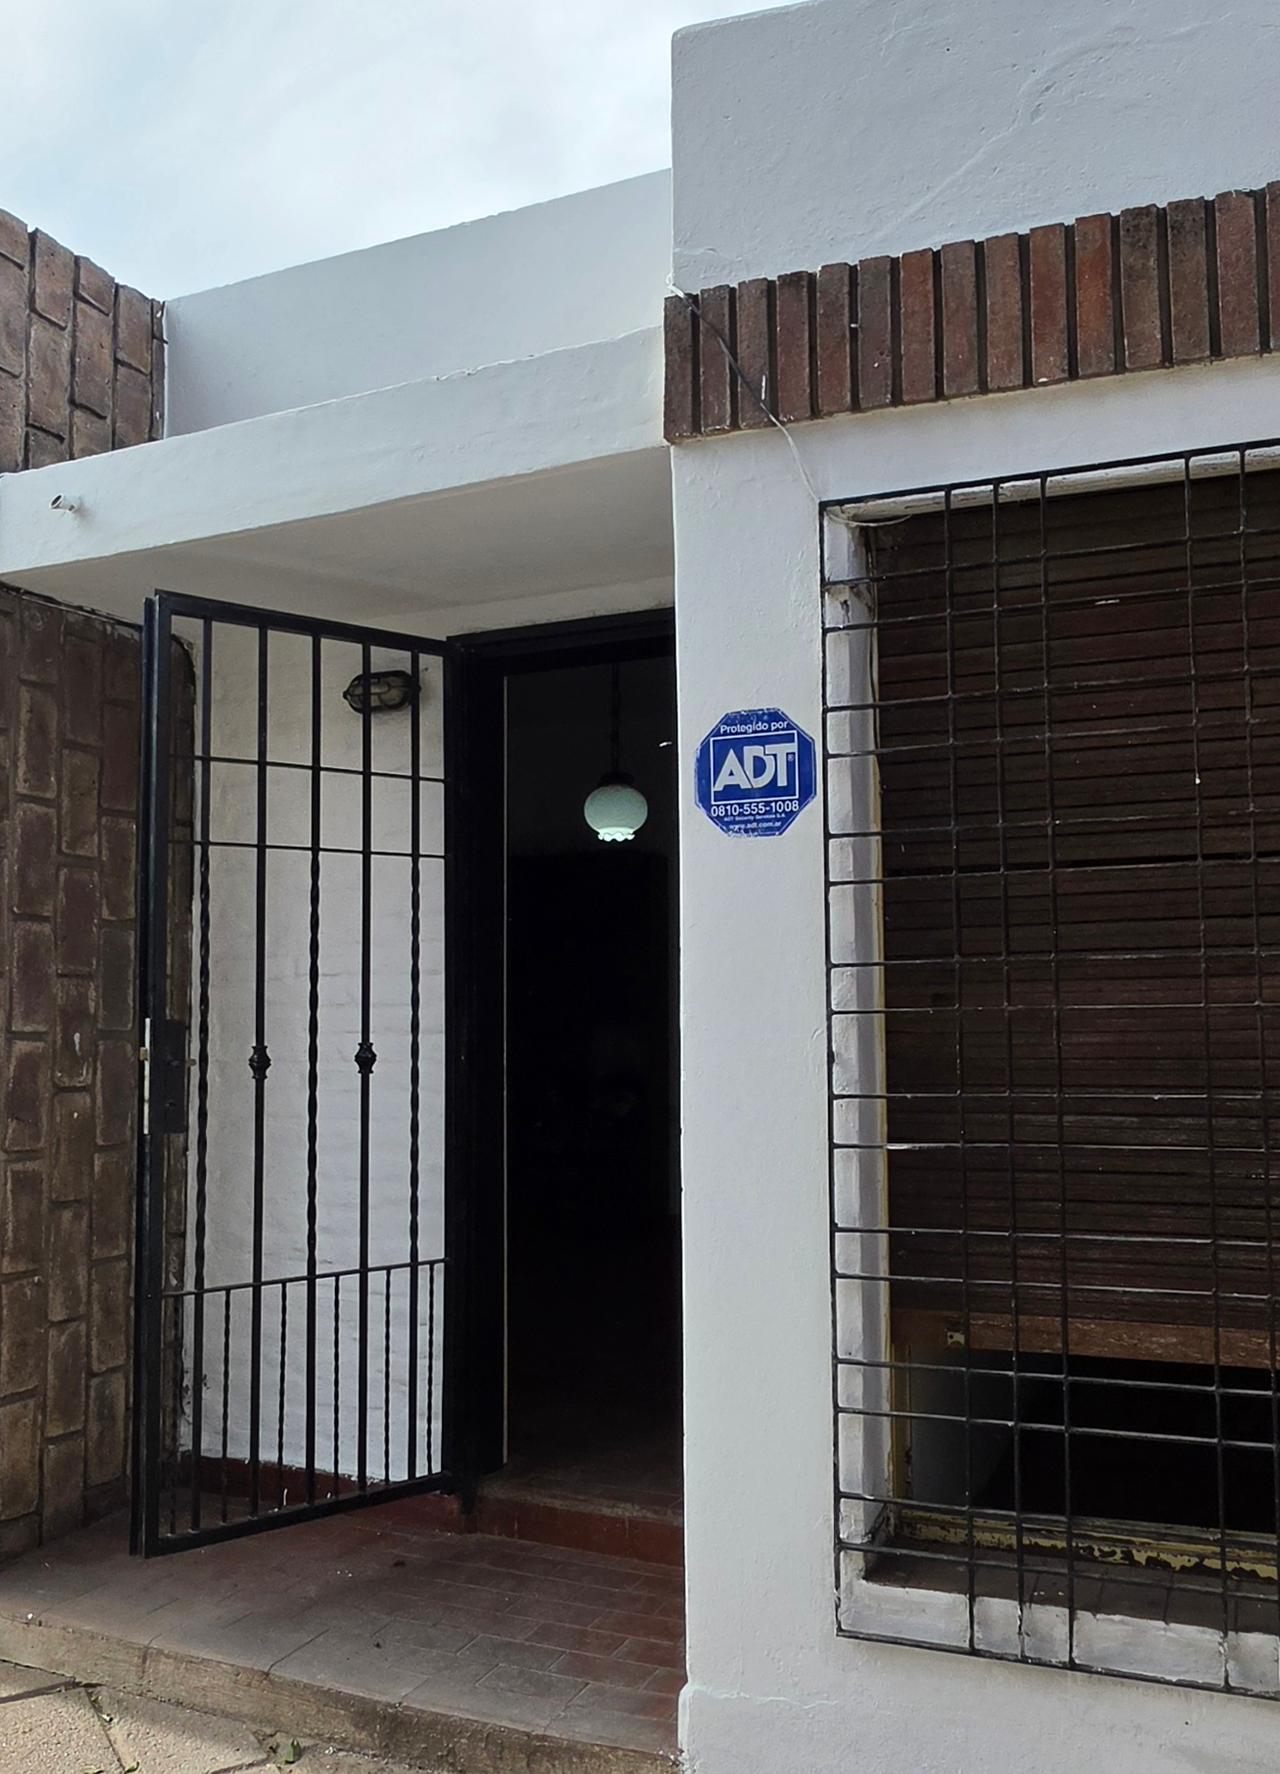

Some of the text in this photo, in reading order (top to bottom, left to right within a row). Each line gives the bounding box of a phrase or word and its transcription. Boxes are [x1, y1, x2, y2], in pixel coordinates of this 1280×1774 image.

[720, 721, 789, 734] Protegido por
[713, 743, 797, 791] ADT
[711, 801, 799, 817] 0810-555-1008
